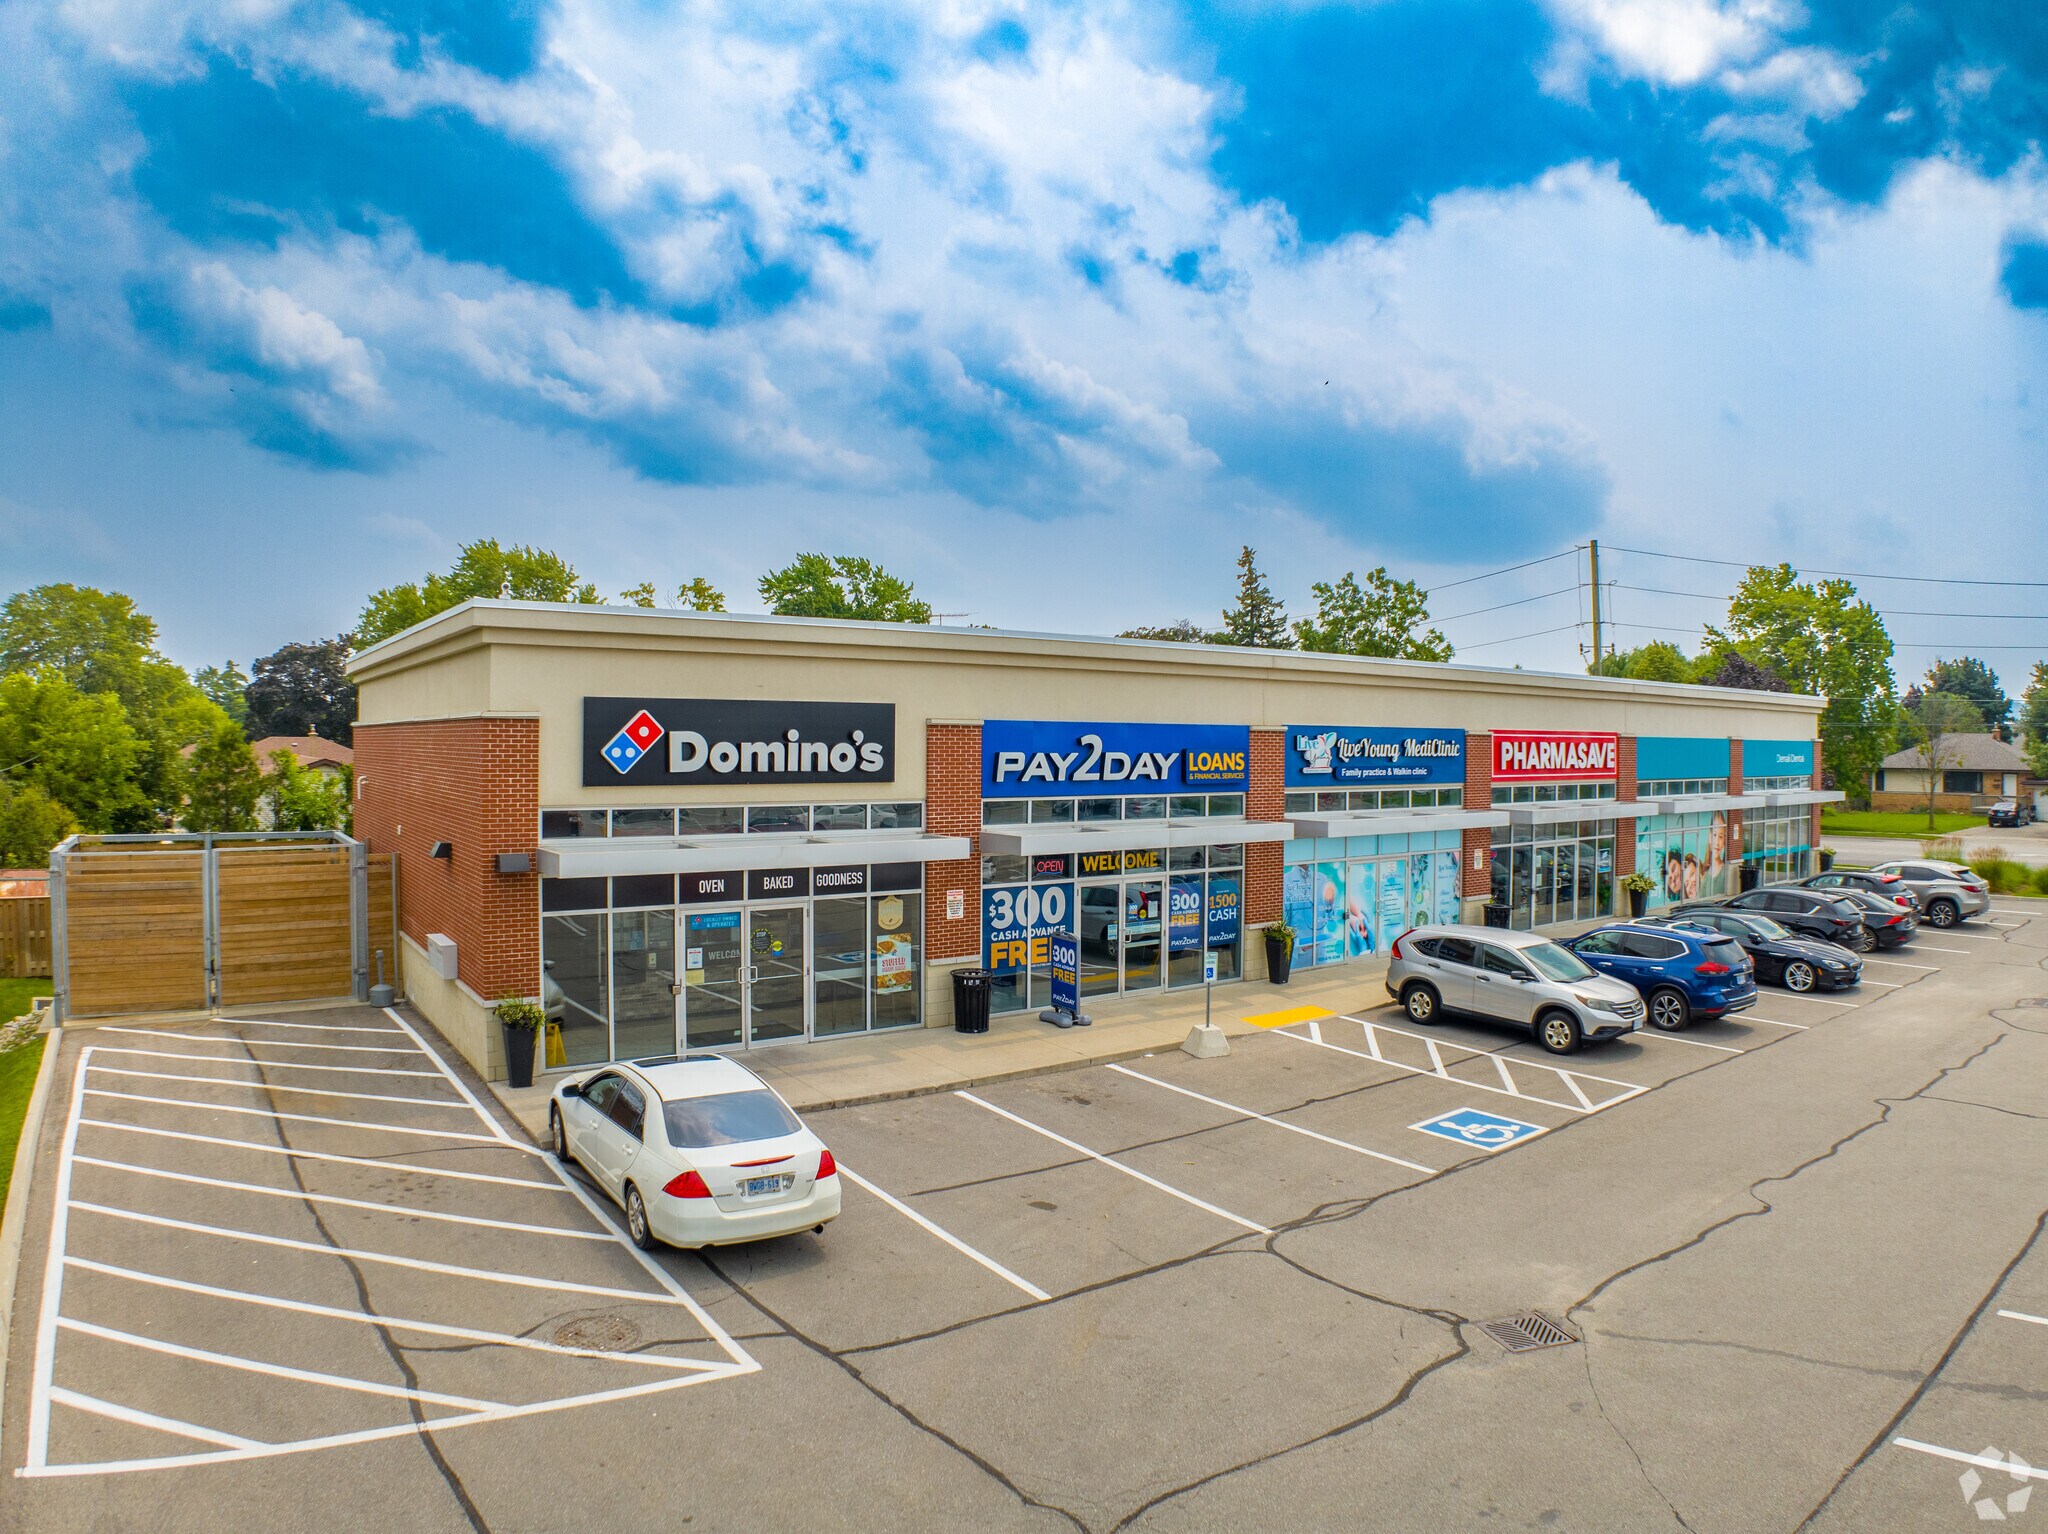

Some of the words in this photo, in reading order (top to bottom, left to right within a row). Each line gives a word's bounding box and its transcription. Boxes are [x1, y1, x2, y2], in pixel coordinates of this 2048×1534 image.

[669, 729, 884, 773] Domino's
[996, 734, 1180, 783] PAY2DAY
[1501, 741, 1615, 770] PHARMASAVE
[1189, 752, 1245, 771] LOANS
[1221, 772, 1245, 780] SERVICES
[1341, 768, 1361, 778] Family
[1363, 768, 1386, 778] practice
[1387, 768, 1392, 776] &
[1393, 767, 1412, 776] Walkin
[1412, 767, 1428, 775] clinic
[1036, 860, 1064, 872] OPEN
[1083, 852, 1158, 872] WELCOME
[699, 879, 725, 893] OVEN
[764, 875, 793, 890] BAKED
[816, 872, 863, 886] GOODNESS
[988, 886, 1066, 929] $300
[1208, 908, 1237, 921] CASH
[1171, 914, 1200, 926] FREE
[991, 930, 1019, 941] CASH
[1171, 936, 1199, 946] PAY2DAY
[1208, 932, 1236, 942] PAY2DAY
[990, 937, 1052, 969] FRE
[1053, 967, 1076, 985] FREE
[1052, 993, 1075, 1005] PAY2DAY
